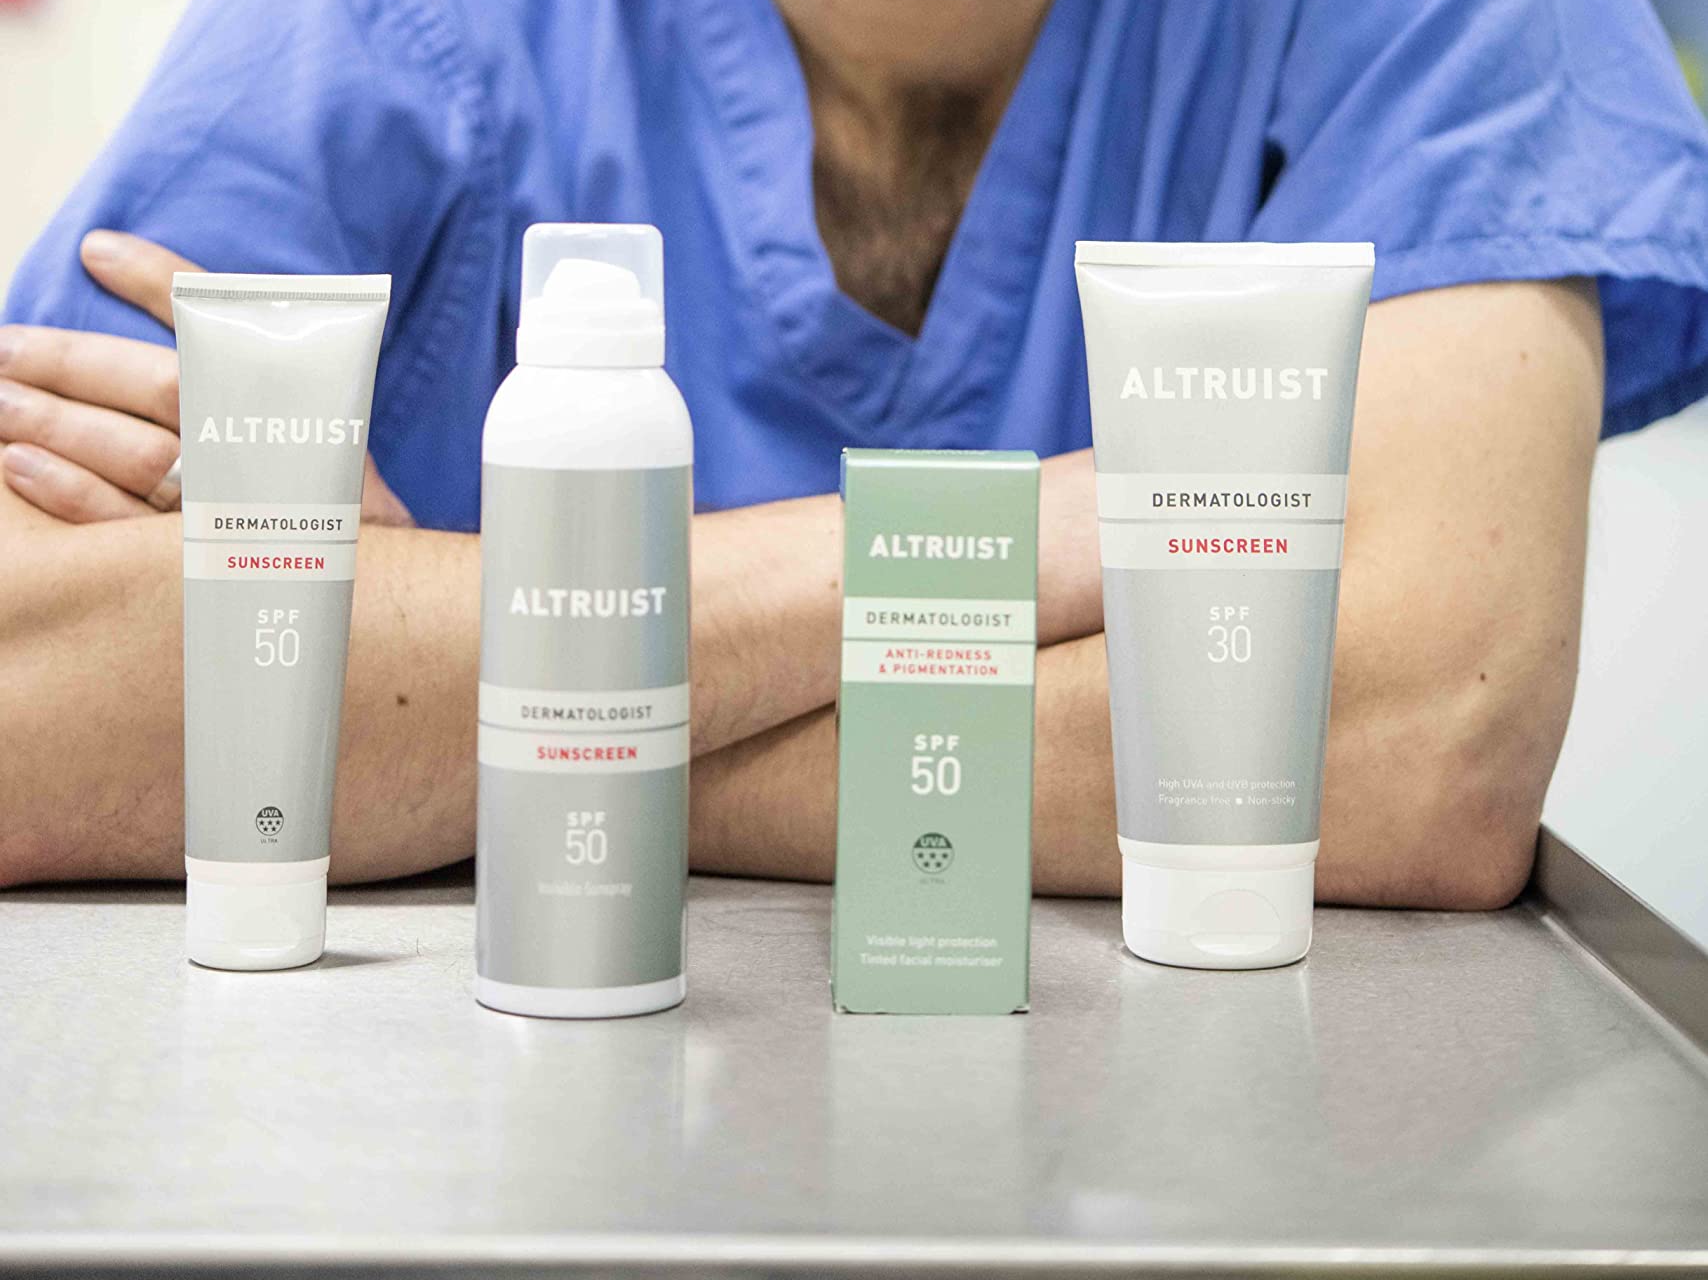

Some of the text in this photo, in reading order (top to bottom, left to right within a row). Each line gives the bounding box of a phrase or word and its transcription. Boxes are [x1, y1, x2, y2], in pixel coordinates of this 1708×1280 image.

[1119, 367, 1329, 400] ALTRUIST
[198, 417, 364, 446] ALTRUIST
[1152, 493, 1312, 508] DERMATOLOGIST
[214, 517, 344, 532] DERMATOLOGIST
[869, 535, 1014, 560] ALTRUIST
[1168, 538, 1288, 554] SUNSCREEN
[227, 556, 325, 570] SUNSCREEN
[509, 587, 667, 618] ALTRUIST
[257, 609, 300, 625] SPF
[866, 611, 1012, 627] DERMATOLOGIST
[1209, 606, 1250, 621] SPF
[254, 629, 300, 667] 50
[1207, 625, 1251, 663] 30
[886, 649, 992, 660] ANTI-REDNESS
[879, 664, 998, 676] & PIGMENTATION
[521, 705, 653, 721] DERMATOLOGIST
[914, 734, 960, 751] SPF
[537, 746, 638, 760] SUNSCREEN
[911, 756, 962, 796] 50
[1158, 778, 1180, 790] High
[1183, 779, 1203, 789] UVA
[1250, 780, 1296, 791] protection
[1158, 794, 1208, 807] Fragrance
[262, 809, 280, 817] UVA
[567, 811, 606, 827] SPF
[565, 828, 608, 865] 50
[920, 836, 947, 847] UVA
[866, 935, 906, 948] Visible
[938, 936, 998, 949] protection
[860, 953, 1003, 967] Tinted facial moisturiser
